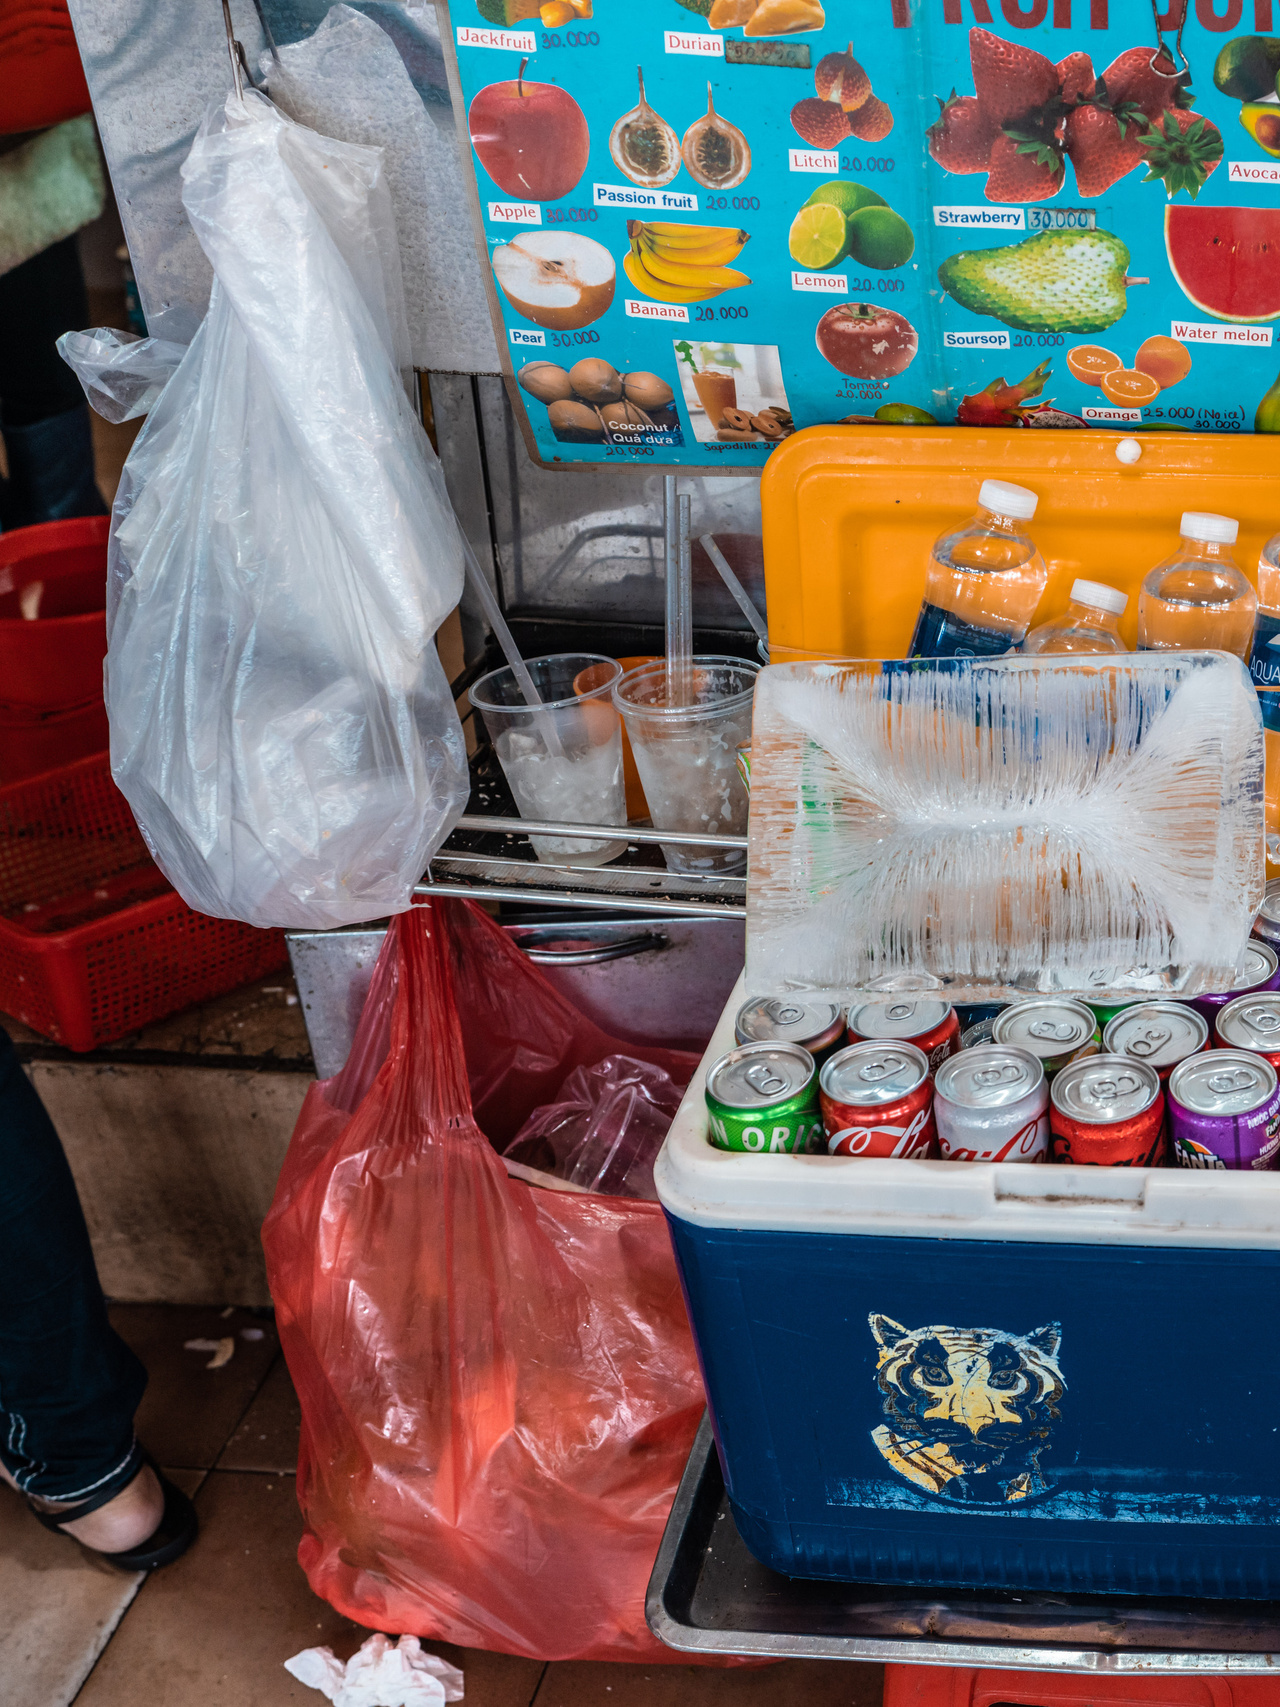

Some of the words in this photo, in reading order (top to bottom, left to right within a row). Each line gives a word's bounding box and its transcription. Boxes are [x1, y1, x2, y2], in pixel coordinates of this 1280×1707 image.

[460, 29, 534, 51] Jackfruit
[541, 31, 600, 49] 30.000
[669, 34, 721, 52] Durian
[794, 154, 838, 168] Litchi
[841, 156, 896, 173] 20.000
[597, 188, 656, 206] Passion
[662, 191, 693, 209] fruit
[705, 195, 761, 211] 20.000
[493, 204, 537, 220] Apple
[546, 208, 598, 224] 30.000
[938, 211, 1021, 226] Strawberry
[1030, 211, 1088, 229] 30.000
[794, 273, 846, 288] Lemon
[852, 278, 905, 293] 20.000
[630, 302, 686, 318] Banana
[695, 305, 749, 322] 20.000
[513, 331, 542, 344] Pear
[551, 330, 600, 347] 30.000
[946, 333, 1007, 346] Soursop
[1013, 334, 1065, 347] 20.000
[1174, 325, 1217, 339] Water
[1223, 329, 1269, 342] melon
[841, 378, 890, 391] Tomato
[835, 390, 882, 400] 20.000
[1086, 408, 1139, 421] Orange
[1143, 407, 1195, 419] 25.000
[608, 420, 669, 433] Coconut
[1193, 420, 1241, 430] 30.000
[613, 432, 642, 444] Quả
[645, 432, 673, 445] dừa
[605, 446, 655, 457] 20.000
